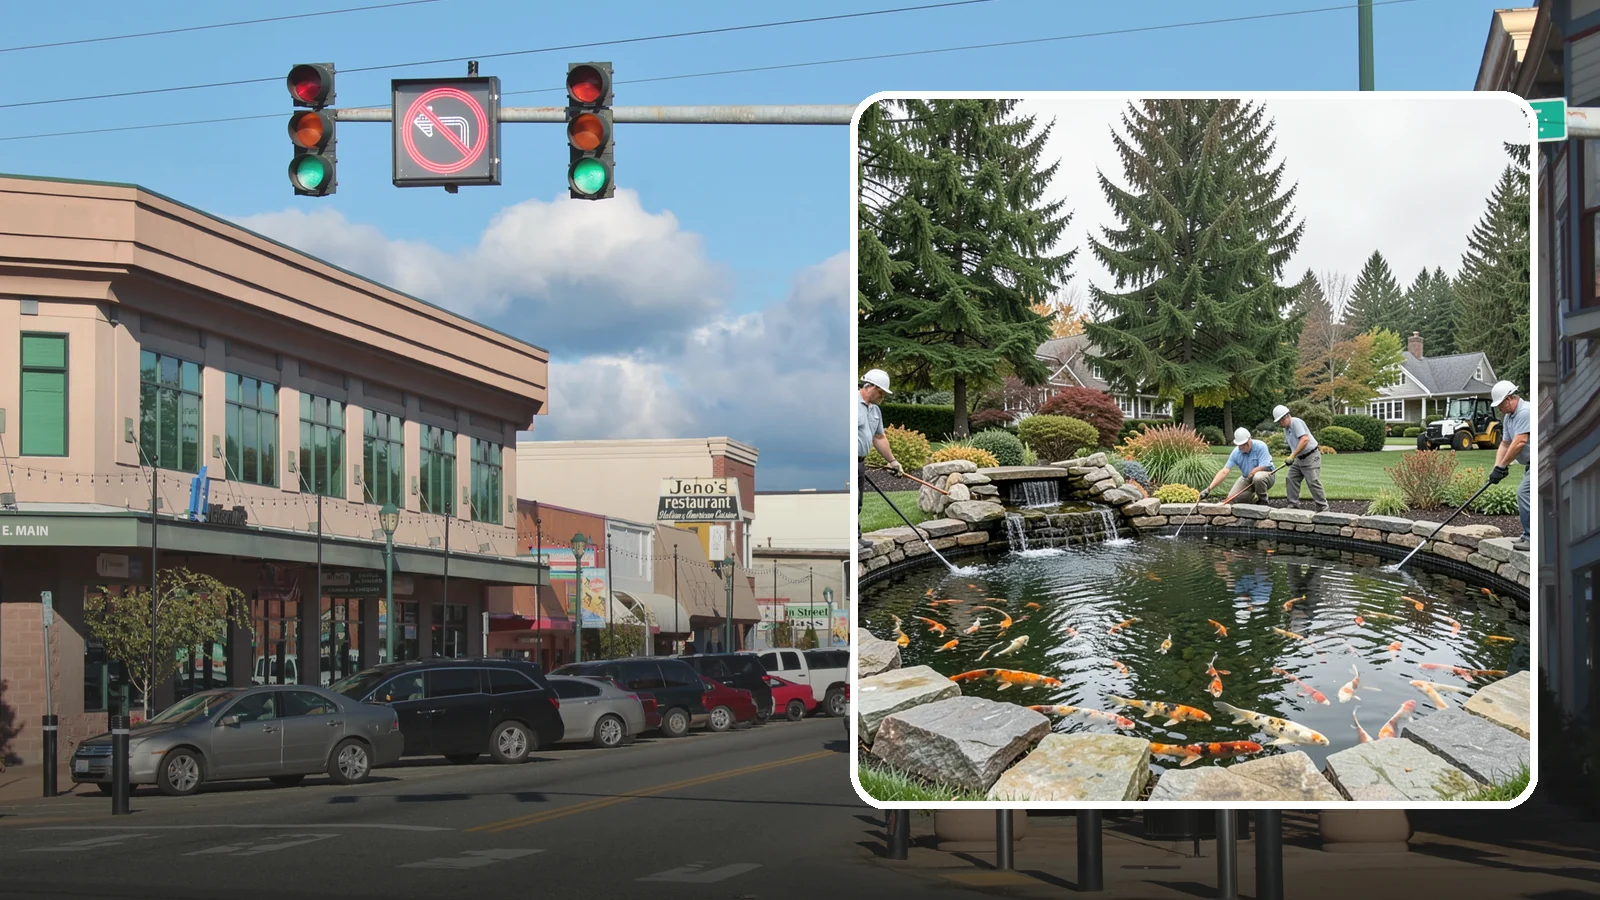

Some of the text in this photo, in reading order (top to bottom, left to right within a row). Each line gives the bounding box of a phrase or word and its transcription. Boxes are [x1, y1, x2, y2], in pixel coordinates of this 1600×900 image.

[670, 480, 727, 494] Jeno's
[665, 496, 731, 509] restaurant
[658, 509, 681, 519] Italian
[686, 509, 714, 519] American
[715, 509, 737, 519] Cuisine
[2, 525, 49, 536] E. MAIN
[797, 607, 829, 617] Street
